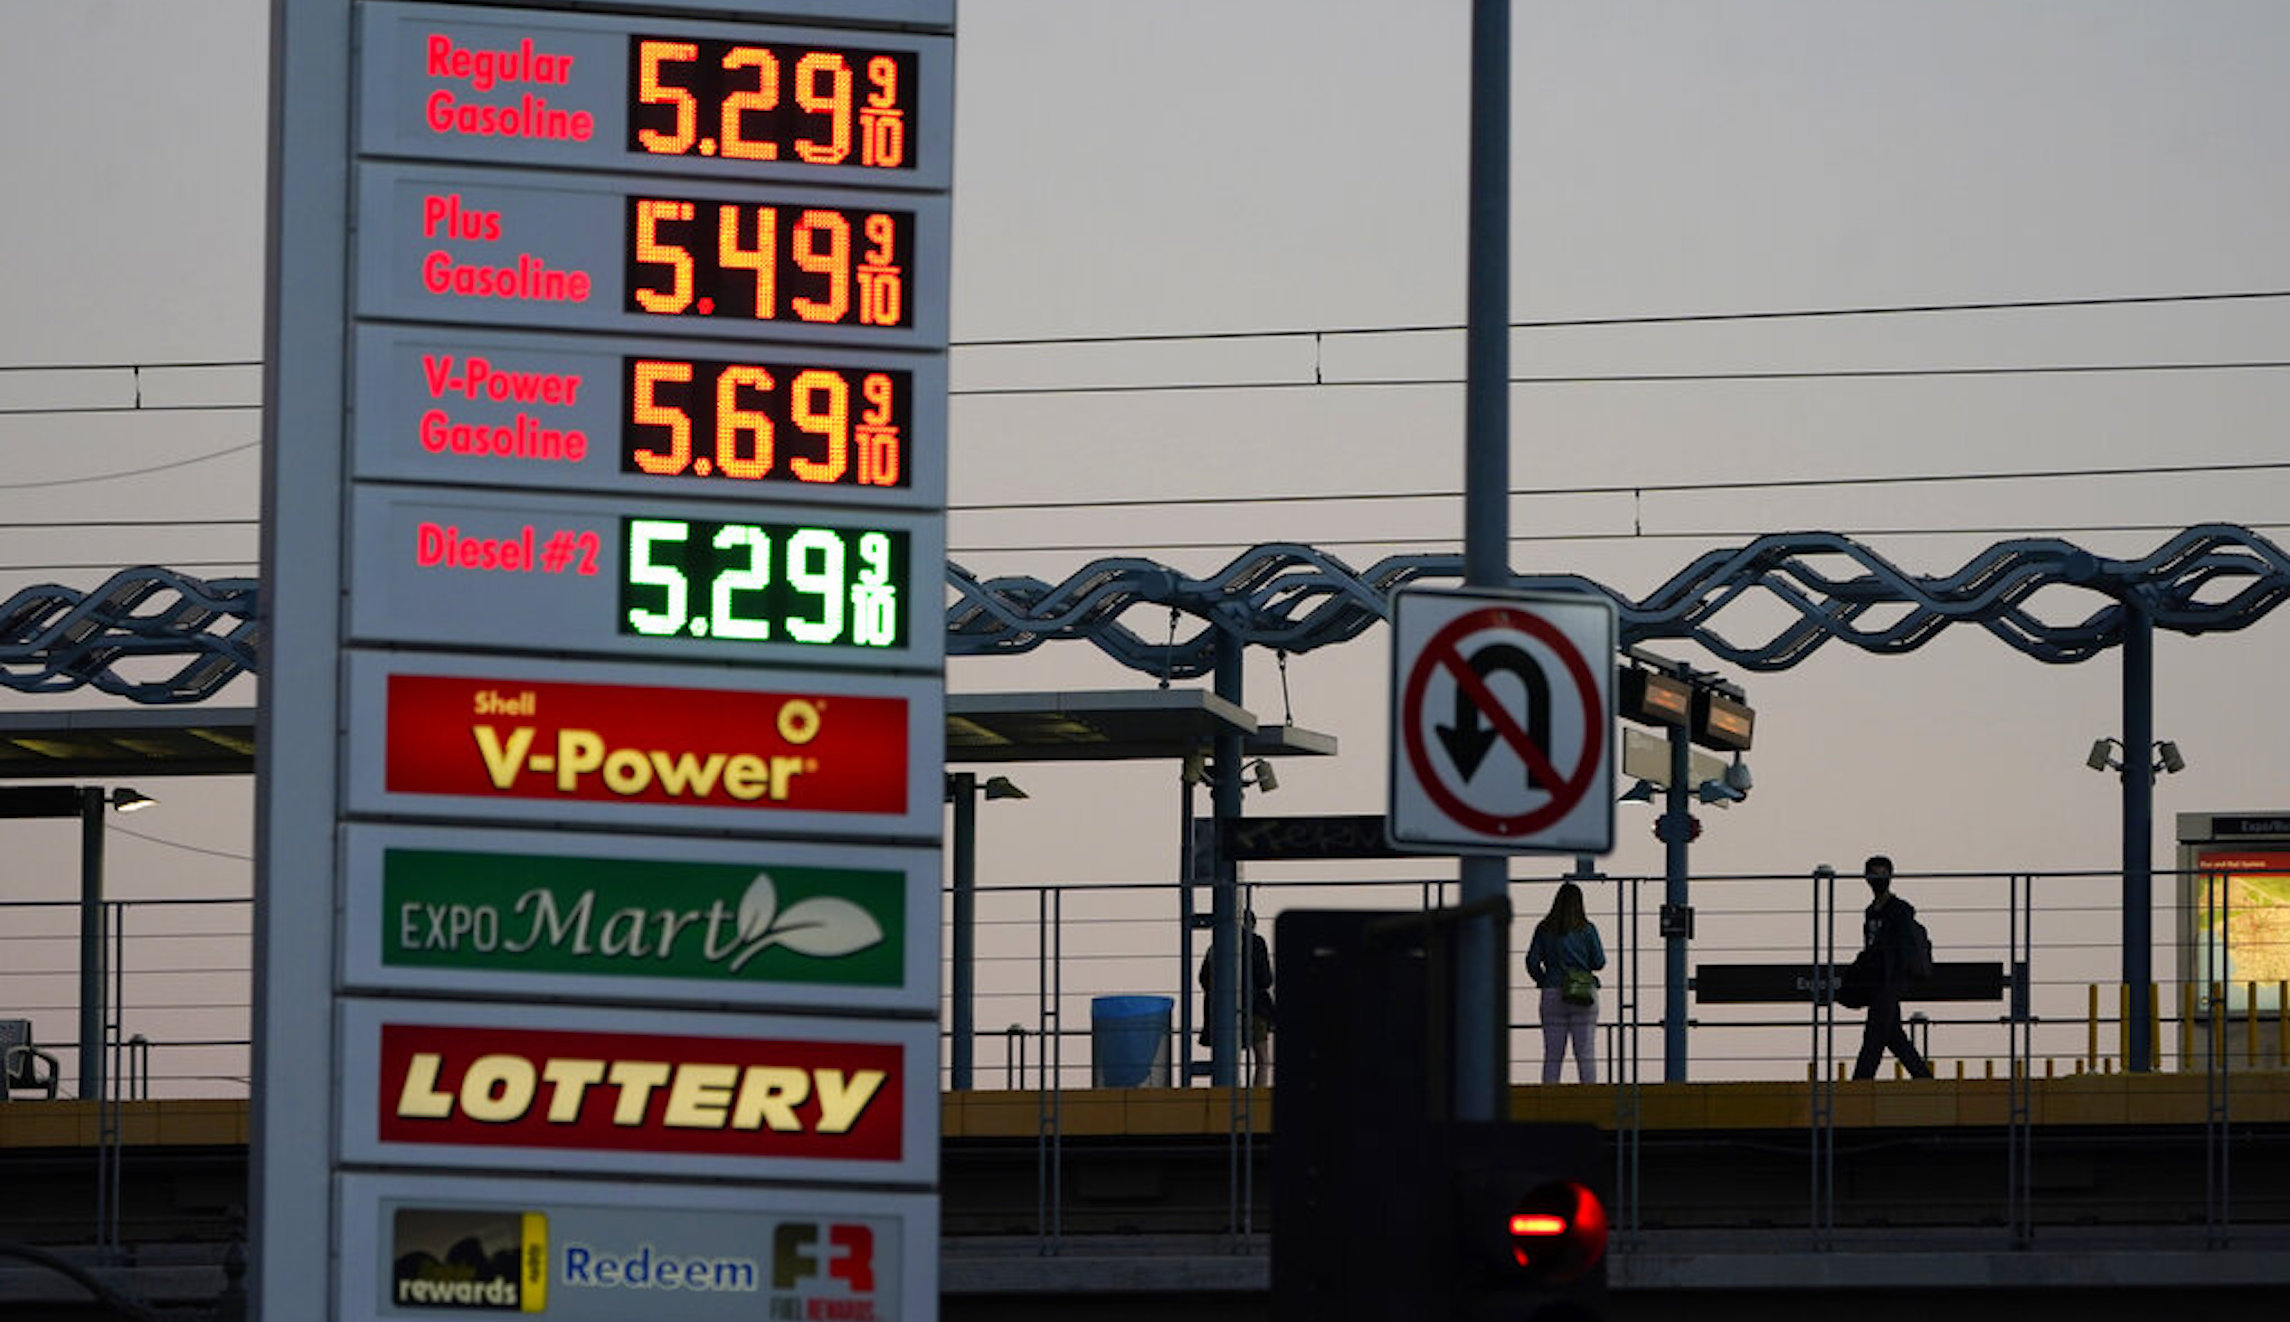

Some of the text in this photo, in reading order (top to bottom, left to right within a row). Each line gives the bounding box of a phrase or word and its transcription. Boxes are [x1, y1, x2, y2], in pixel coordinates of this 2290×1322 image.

[427, 34, 574, 92] Regular
[426, 90, 594, 142] Gasoline
[638, 40, 853, 164] 5.29
[424, 194, 501, 242] Plus
[422, 251, 591, 302] Gasoline
[635, 200, 851, 323] 5.49
[422, 354, 582, 406] V-Power
[419, 410, 587, 462] Gasoline
[633, 360, 849, 483] 5.69
[417, 522, 600, 576] Diesel #2
[629, 519, 846, 645] 5.29
[474, 690, 536, 716] Shell
[473, 725, 802, 800] V-Power
[402, 889, 742, 961] EXPO Mart
[397, 1054, 886, 1133] LOTTERY
[400, 1276, 518, 1306] rewards
[564, 1246, 757, 1289] Redeem
